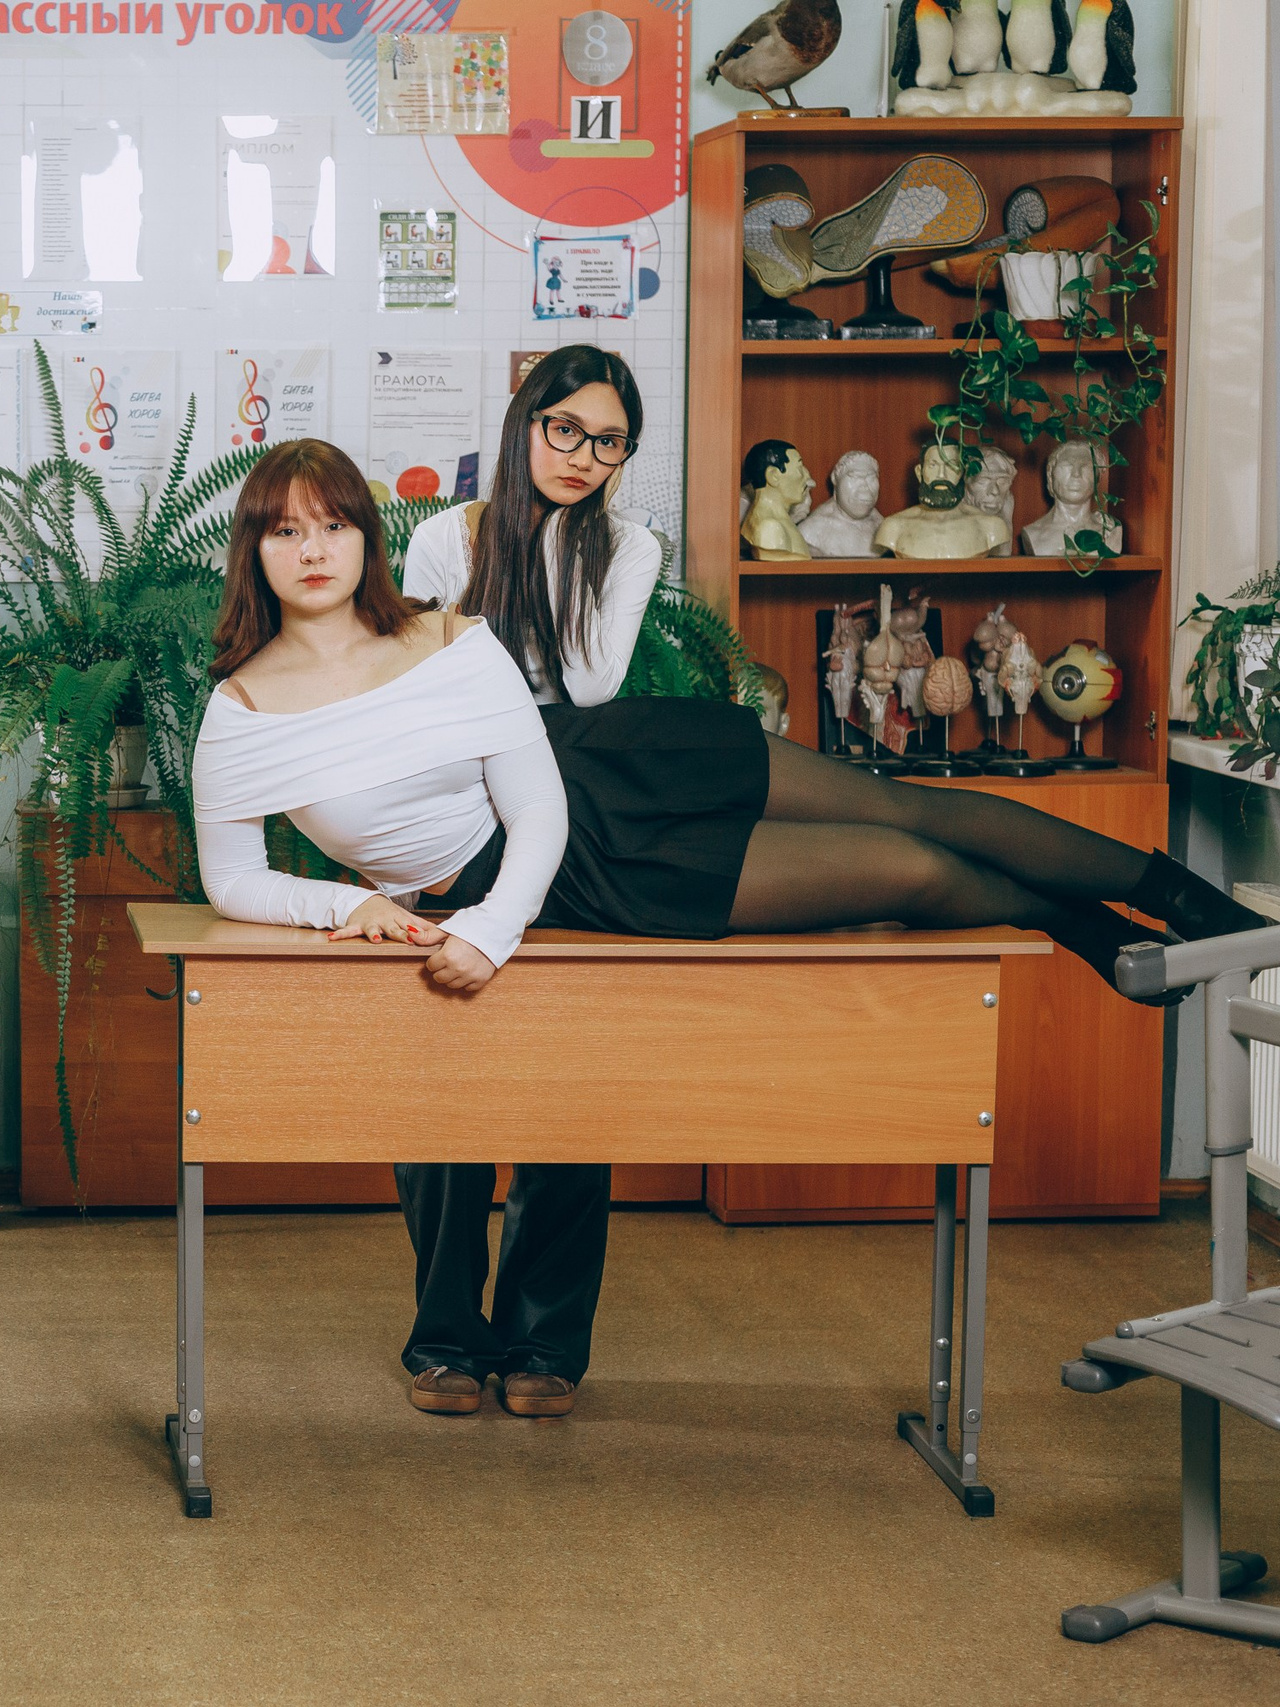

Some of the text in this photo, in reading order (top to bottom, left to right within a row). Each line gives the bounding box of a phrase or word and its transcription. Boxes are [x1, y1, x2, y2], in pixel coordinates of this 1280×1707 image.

[176, 2, 343, 46] уголок
[584, 24, 608, 60] 8
[574, 99, 618, 140] И
[374, 375, 447, 386] ГРАМОТА
[282, 385, 314, 395] БИТВА
[129, 392, 162, 402] БИТВА
[280, 402, 315, 412] ХОРОВ
[128, 409, 162, 419] ХОРОВ
